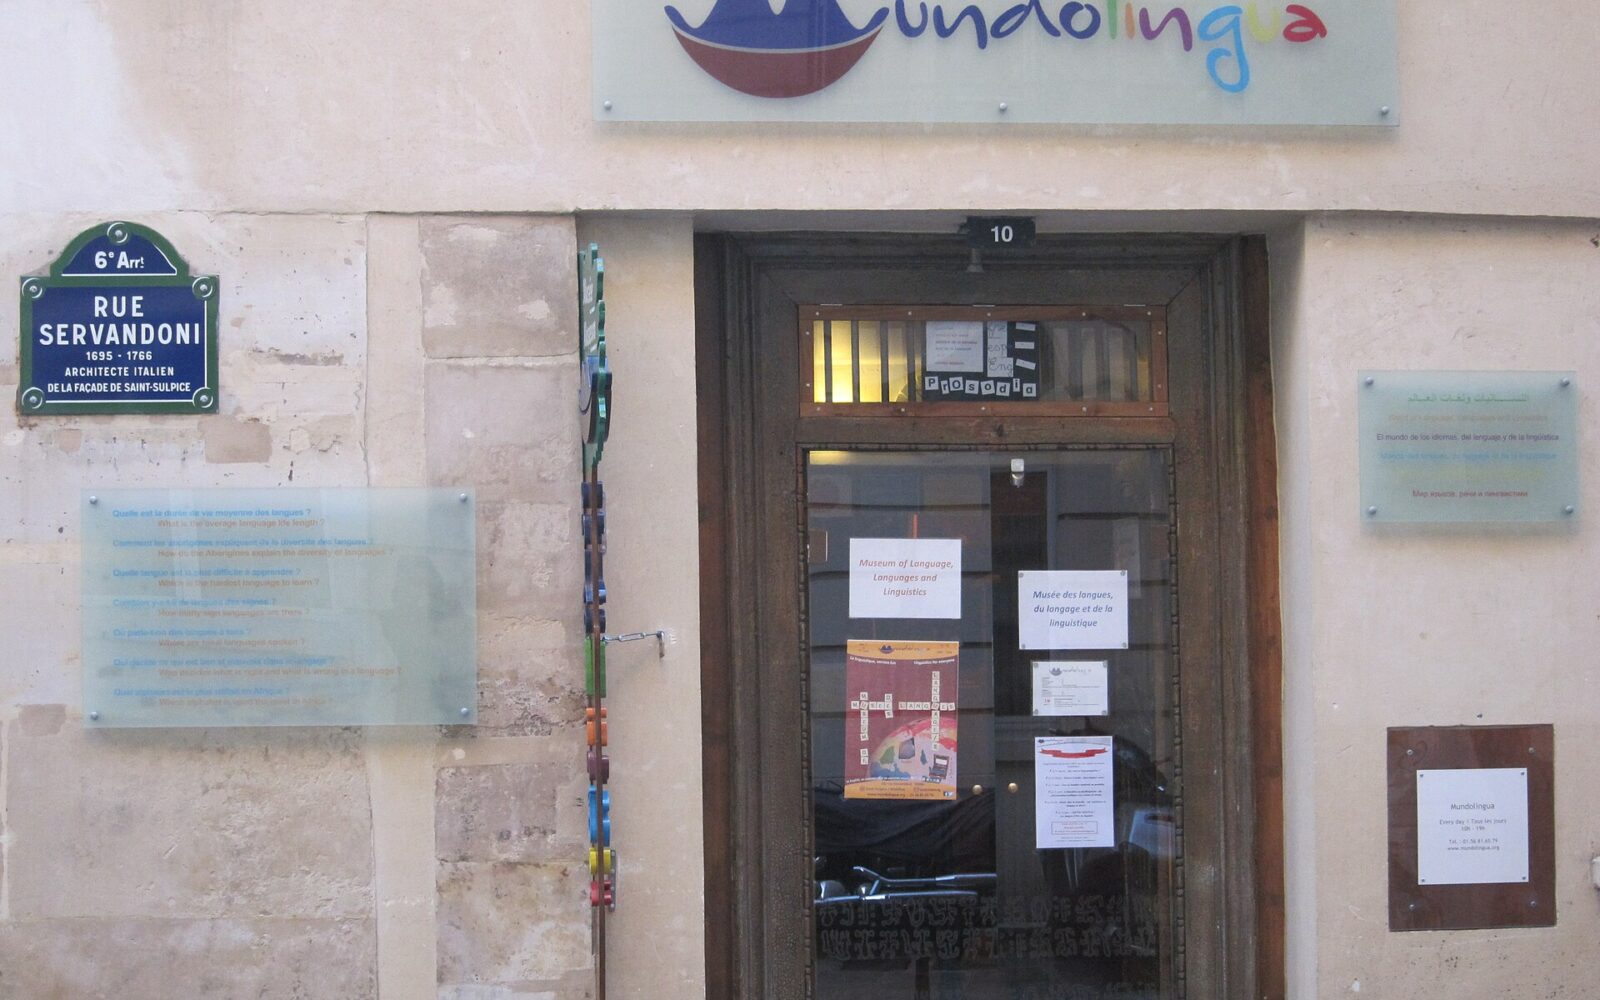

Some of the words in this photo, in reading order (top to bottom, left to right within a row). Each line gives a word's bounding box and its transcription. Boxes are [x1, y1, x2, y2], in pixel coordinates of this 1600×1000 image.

[991, 225, 1014, 243] 10
[94, 295, 145, 318] RUE
[39, 322, 200, 346] SERVANDONI
[86, 351, 113, 361] 1695
[127, 351, 153, 361] 1766
[64, 366, 130, 376] ARCHITECTE
[133, 366, 175, 376] ITALIEN
[47, 382, 61, 392] DE
[61, 382, 74, 392] LA
[74, 382, 109, 393] FAÇADE
[110, 382, 124, 392] DE
[124, 382, 191, 392] SAINT-SULPICE
[1377, 433, 1384, 441] El
[1385, 433, 1408, 441] mundo
[1410, 433, 1418, 441] de
[1420, 433, 1430, 441] los
[1461, 433, 1472, 441] del
[1508, 433, 1517, 441] de
[858, 560, 896, 568] Museum
[898, 560, 908, 568] of
[909, 560, 954, 569] Language,
[873, 574, 919, 583] Languages
[921, 574, 938, 582] and
[883, 588, 927, 598] Linguistics
[1032, 590, 1061, 598] Musée
[1062, 590, 1077, 598] des
[1078, 590, 1114, 600] langues,
[1046, 605, 1080, 614] langage
[1049, 619, 1098, 628] linguistique
[1450, 803, 1495, 811] Mundolingua
